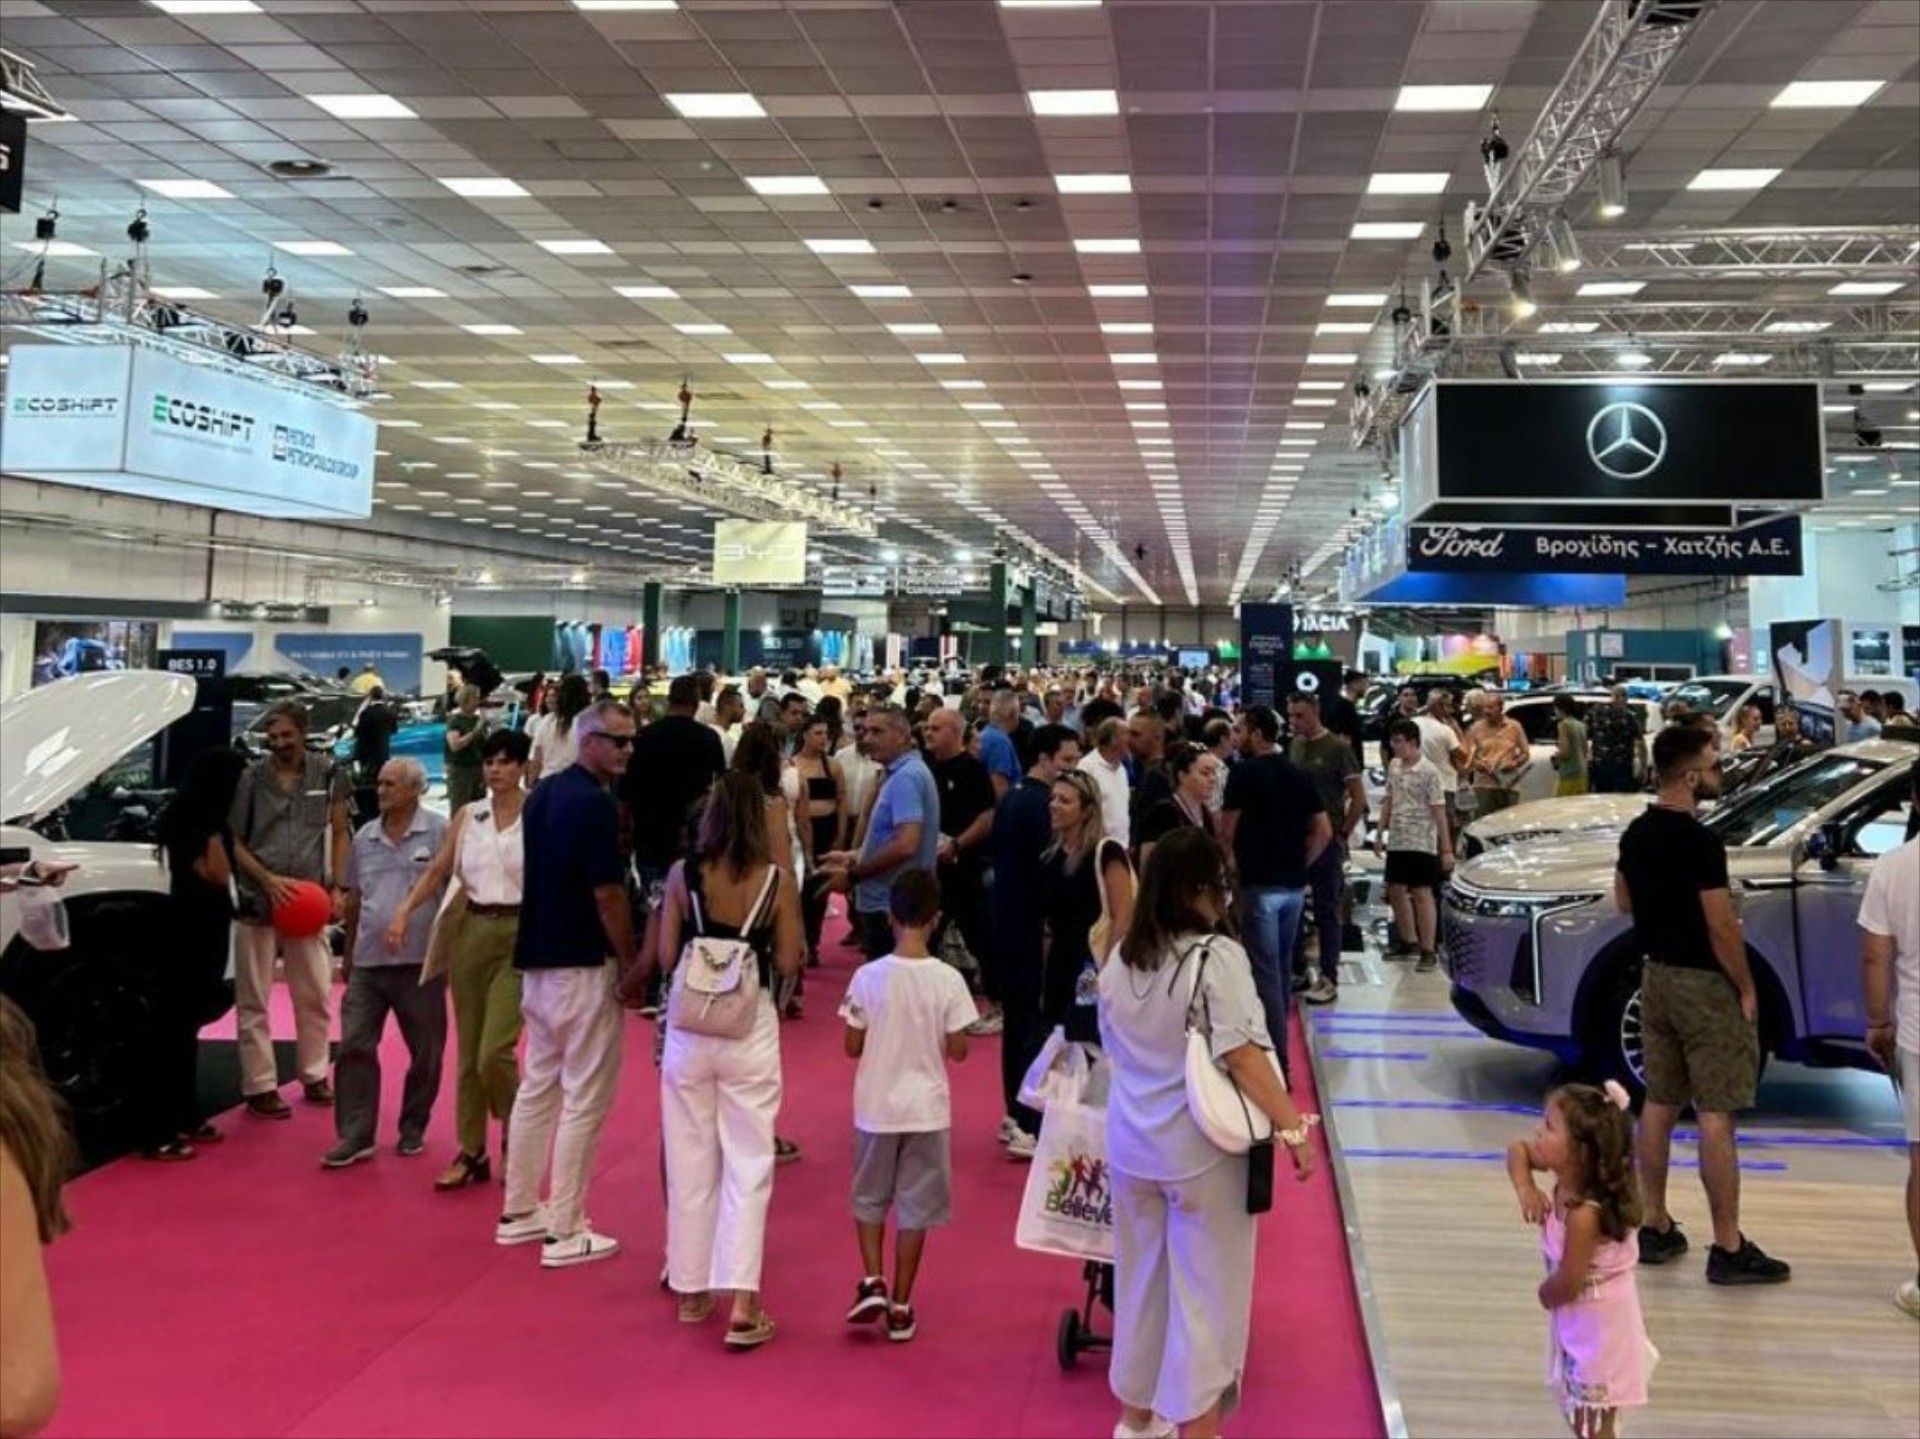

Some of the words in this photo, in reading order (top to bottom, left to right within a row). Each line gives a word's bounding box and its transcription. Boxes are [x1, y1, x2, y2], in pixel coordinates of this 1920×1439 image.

[1420, 526, 1504, 557] Ford
[1536, 535, 1640, 558] Βροχίδης
[1665, 536, 1743, 559] Χατζής
